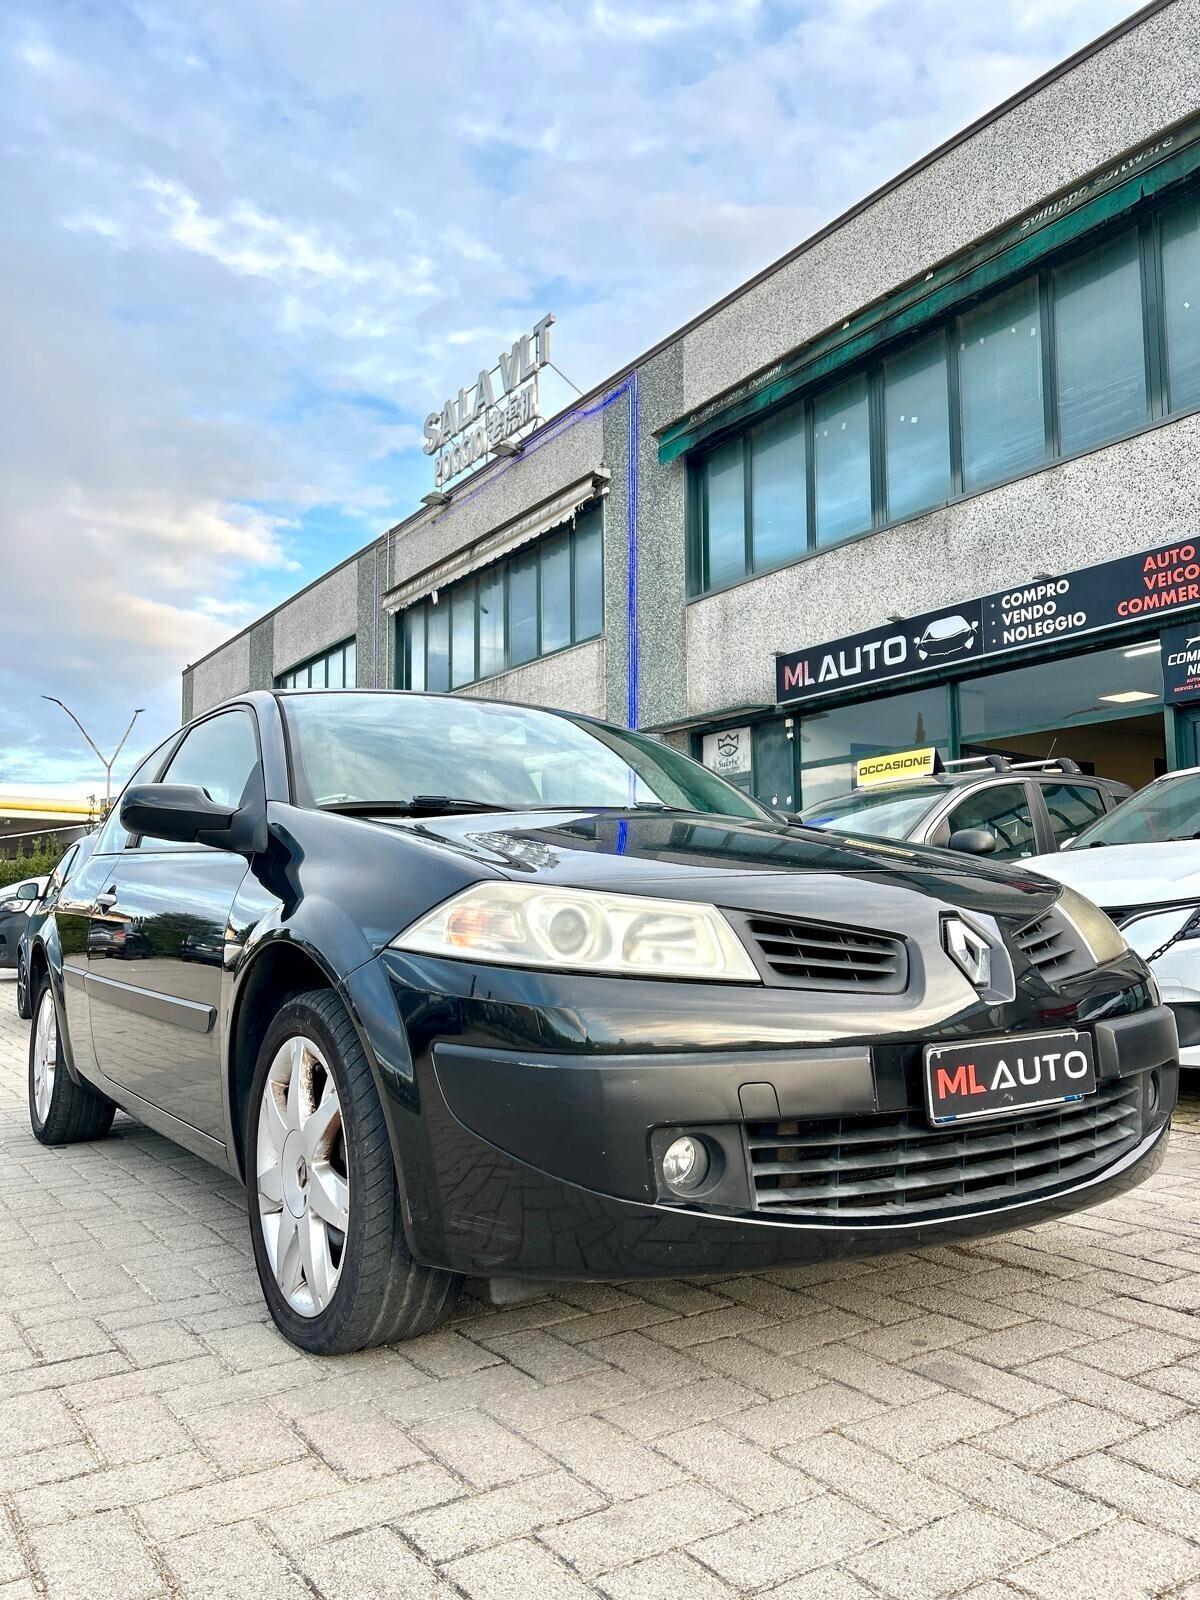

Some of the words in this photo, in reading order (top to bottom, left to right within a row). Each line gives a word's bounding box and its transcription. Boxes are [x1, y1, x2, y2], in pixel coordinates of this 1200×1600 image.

[1020, 185, 1089, 231] Sviluppo
[423, 369, 495, 455] SALA
[499, 312, 556, 394] VLT
[435, 426, 488, 487] POGGIO
[1143, 545, 1196, 572] AUTO
[1001, 579, 1070, 609] COMPRO
[1002, 601, 1057, 627] VENDO
[1003, 611, 1087, 645] NOLEGGIO
[859, 755, 932, 777] OCCASIONE
